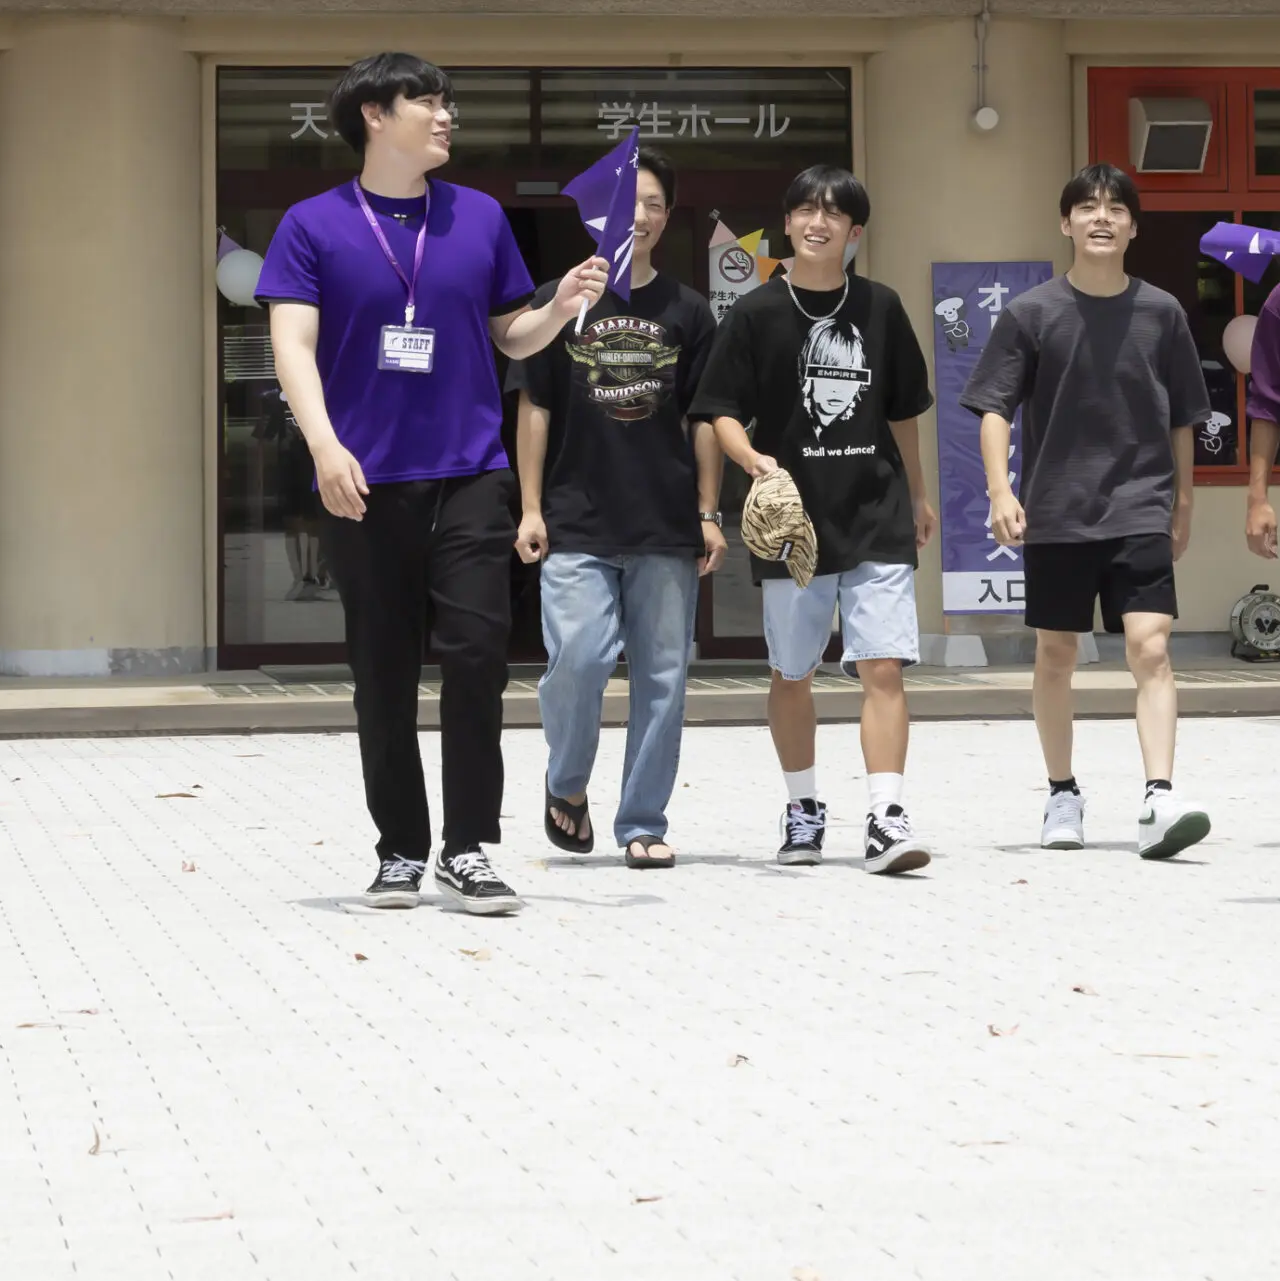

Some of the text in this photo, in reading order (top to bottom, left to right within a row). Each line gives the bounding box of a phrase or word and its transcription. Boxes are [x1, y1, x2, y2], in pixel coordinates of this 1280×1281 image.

[597, 101, 791, 140] 学生ホール
[402, 337, 430, 351] STAFF
[594, 379, 662, 401] DAVIDSON
[802, 446, 825, 457] Shall
[844, 445, 876, 456] dance?
[978, 578, 1026, 605] 入口
